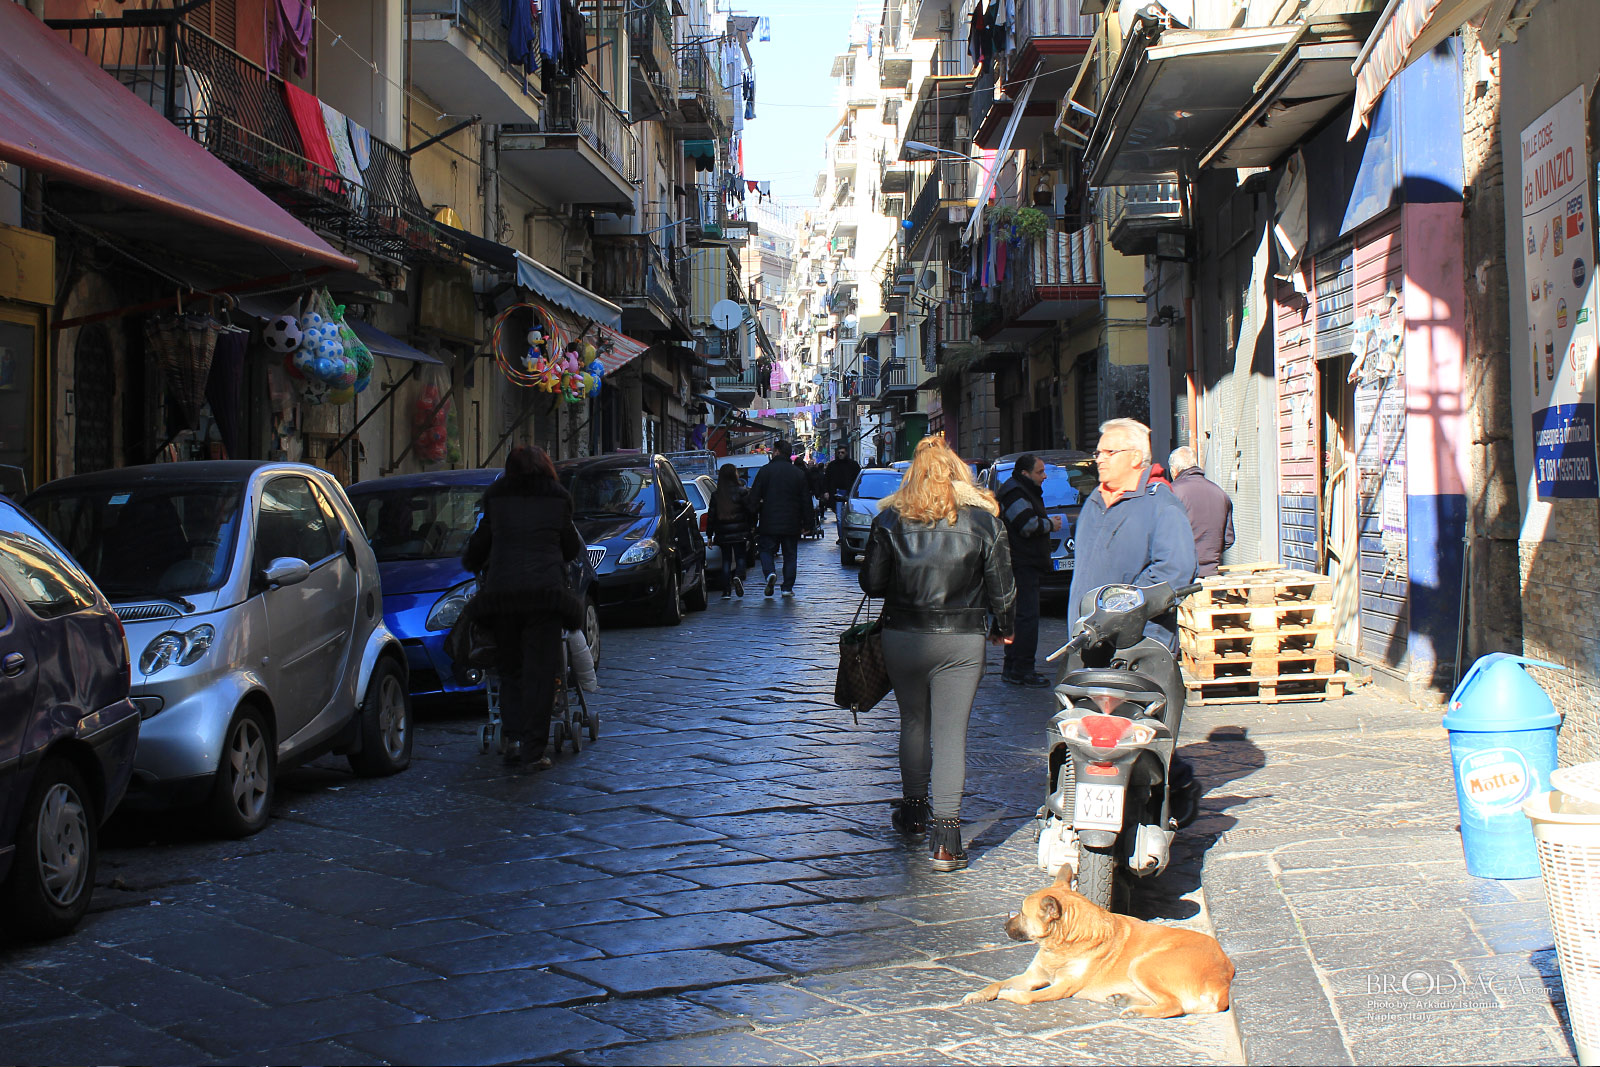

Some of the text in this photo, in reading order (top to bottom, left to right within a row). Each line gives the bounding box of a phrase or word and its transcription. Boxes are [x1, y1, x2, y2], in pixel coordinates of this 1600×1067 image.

[1522, 121, 1553, 162] MILLE COSE
[1524, 146, 1574, 209] da NUNZIO
[1566, 194, 1583, 217] PEPSI
[1536, 418, 1590, 452] consegne a domicilio
[1470, 773, 1520, 794] Motta
